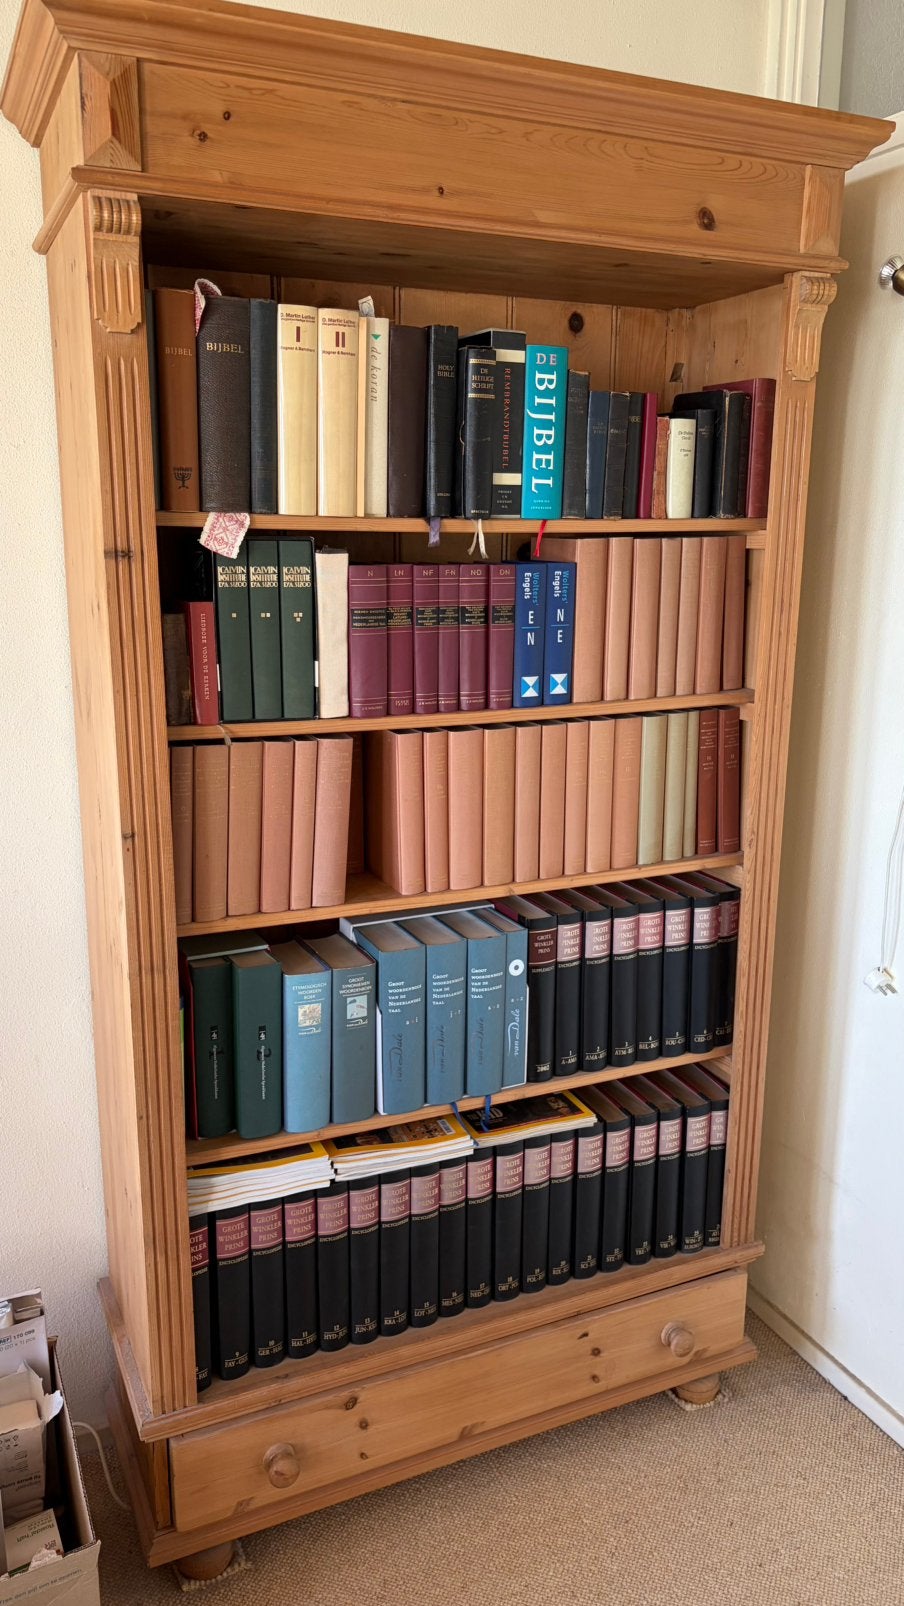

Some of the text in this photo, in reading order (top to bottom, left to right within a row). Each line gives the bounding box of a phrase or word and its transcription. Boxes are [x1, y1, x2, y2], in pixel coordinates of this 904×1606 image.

[335, 331, 345, 348] II
[165, 346, 193, 356] BIJBEL
[206, 342, 244, 354] BIJBEL
[536, 353, 557, 365] DE
[370, 346, 381, 402] de koran
[527, 370, 557, 494] BIJBEL
[367, 569, 374, 577] N
[522, 573, 532, 599] Engels
[553, 571, 562, 598] Engels
[528, 611, 534, 624] E
[557, 609, 564, 622] N
[527, 632, 535, 645] N
[557, 630, 563, 643] E
[203, 665, 209, 673] DE
[256, 1213, 278, 1223] GROTE
[222, 1222, 245, 1233] GROTE
[252, 1221, 282, 1233] WINKLER
[219, 1230, 249, 1242] WINKLER
[259, 1232, 278, 1241] PRINS
[224, 1241, 244, 1251] PRINS
